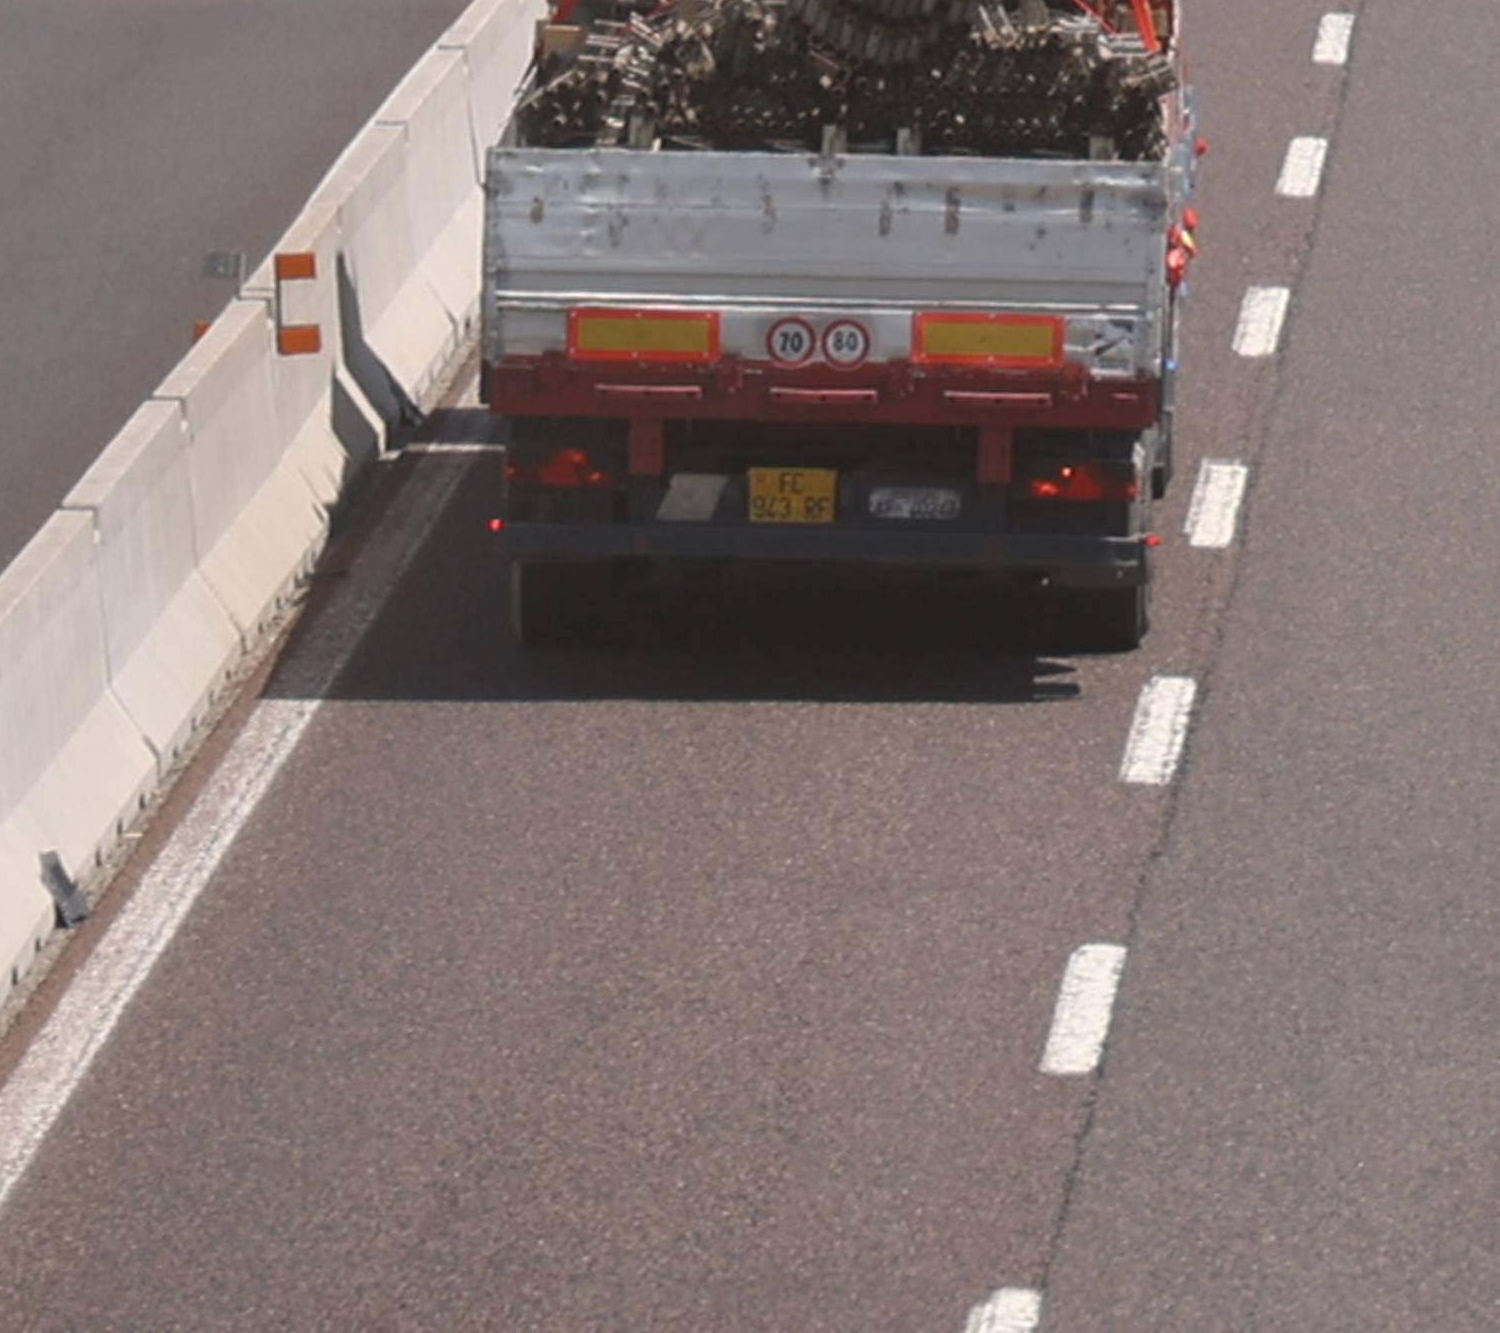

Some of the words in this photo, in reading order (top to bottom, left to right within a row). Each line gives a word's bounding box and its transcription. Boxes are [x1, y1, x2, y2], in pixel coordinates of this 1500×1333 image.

[780, 331, 803, 352] 70
[833, 331, 858, 352] 80
[779, 472, 803, 494] FC
[753, 496, 792, 519] 943
